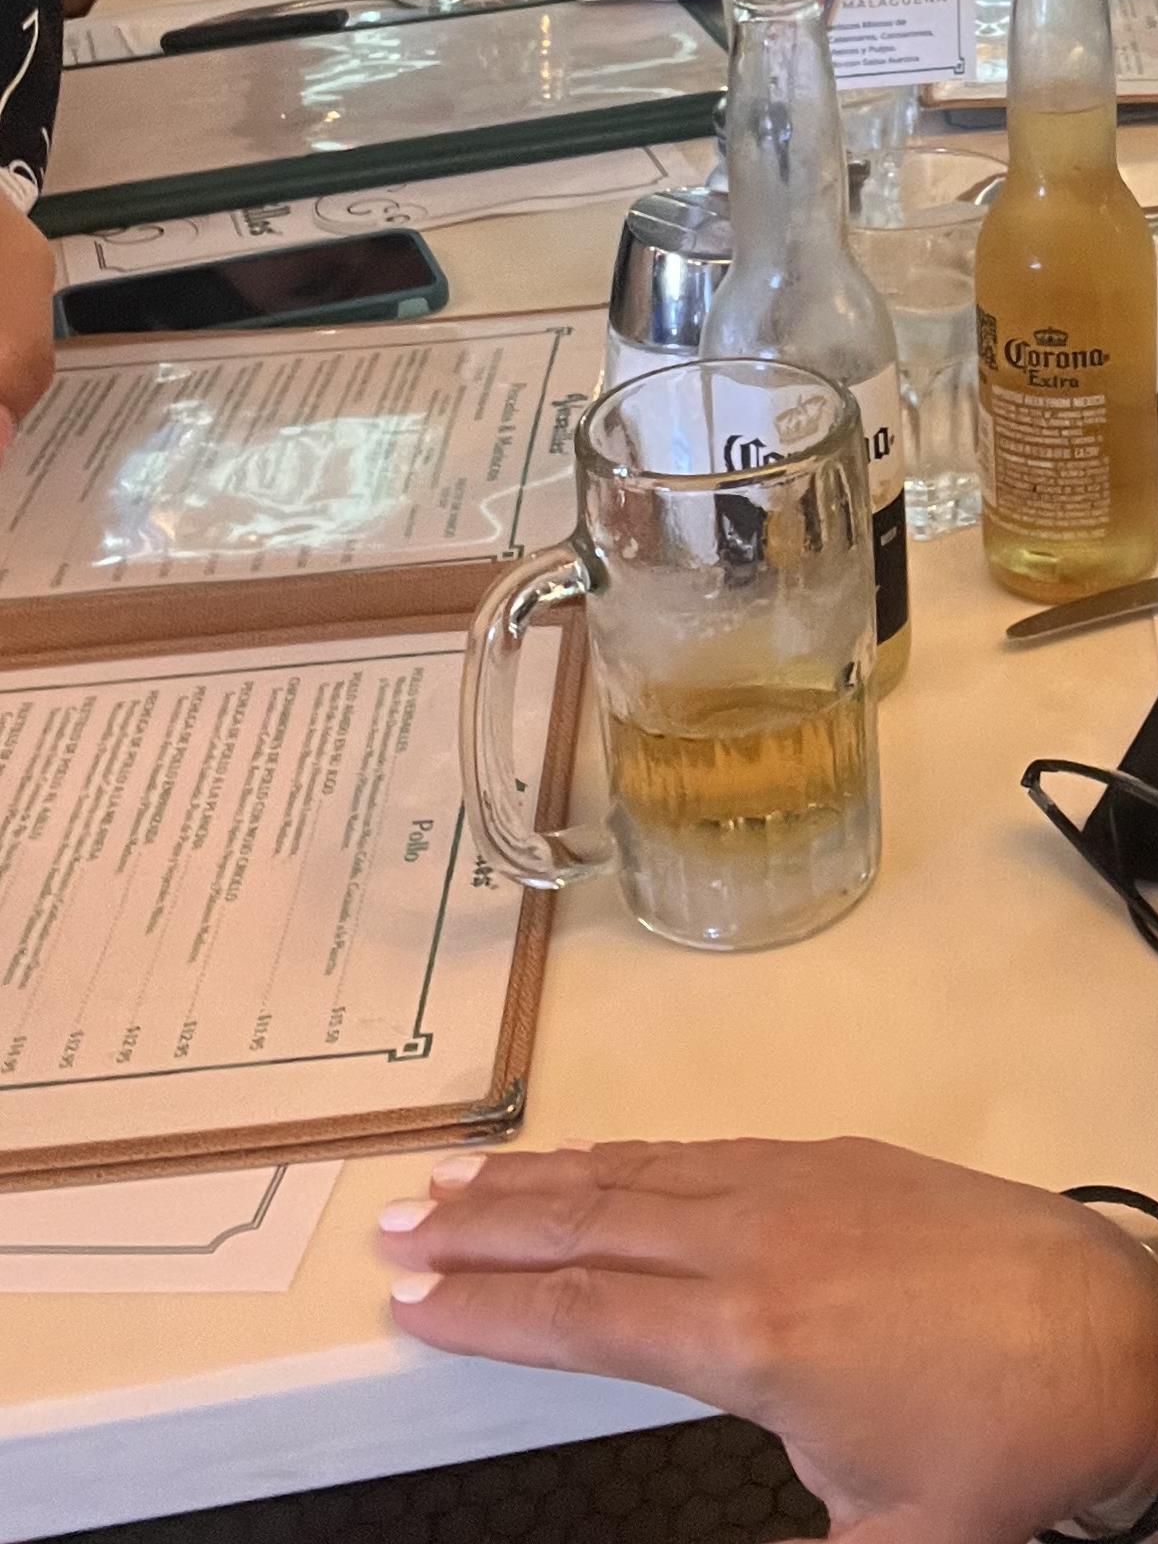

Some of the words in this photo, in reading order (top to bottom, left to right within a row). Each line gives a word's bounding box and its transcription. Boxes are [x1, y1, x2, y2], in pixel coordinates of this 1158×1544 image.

[1004, 338, 1104, 373] Corona
[1027, 369, 1079, 388] Extra
[724, 427, 889, 472] Coa
[401, 818, 434, 863] Pollo
